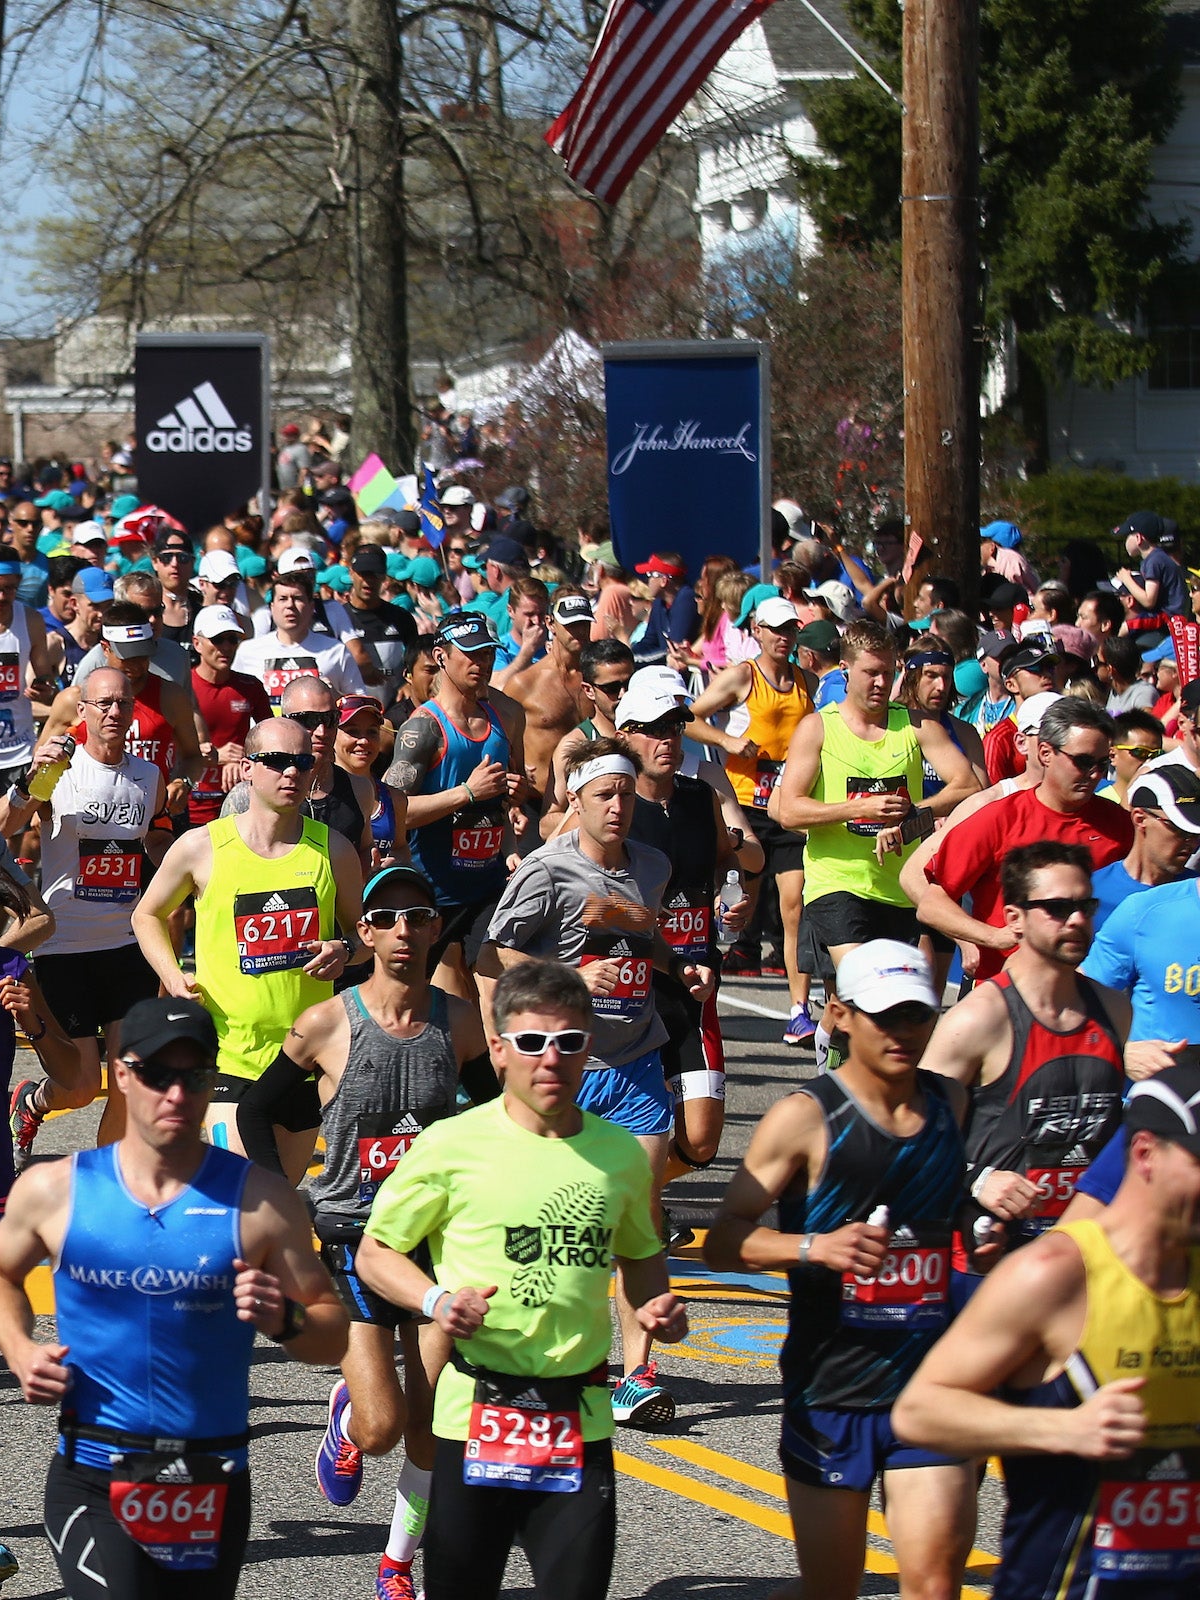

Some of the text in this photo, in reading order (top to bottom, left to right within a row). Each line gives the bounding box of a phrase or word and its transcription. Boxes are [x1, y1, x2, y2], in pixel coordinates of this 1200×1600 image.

[145, 425, 253, 453] adidas
[612, 420, 757, 475] John Hancock
[1187, 642, 1198, 678] TEAM
[81, 801, 145, 826] SVEN
[85, 857, 136, 876] 6531
[263, 902, 289, 912] adidas
[244, 911, 313, 943] 6217
[665, 911, 704, 933] 406
[239, 943, 246, 955] 7
[609, 949, 632, 957] adidas
[255, 960, 287, 969] MARATHON
[620, 961, 647, 985] 68
[392, 1125, 422, 1135] adidas
[368, 1139, 415, 1169] 64
[363, 1169, 370, 1181] 7
[1036, 1171, 1082, 1201] 65
[547, 1225, 612, 1246] TEAM
[548, 1246, 609, 1268] KROC
[510, 1398, 548, 1410] adidas
[478, 1409, 574, 1448] 5282
[468, 1441, 478, 1456] 6
[121, 1488, 216, 1523] 6664
